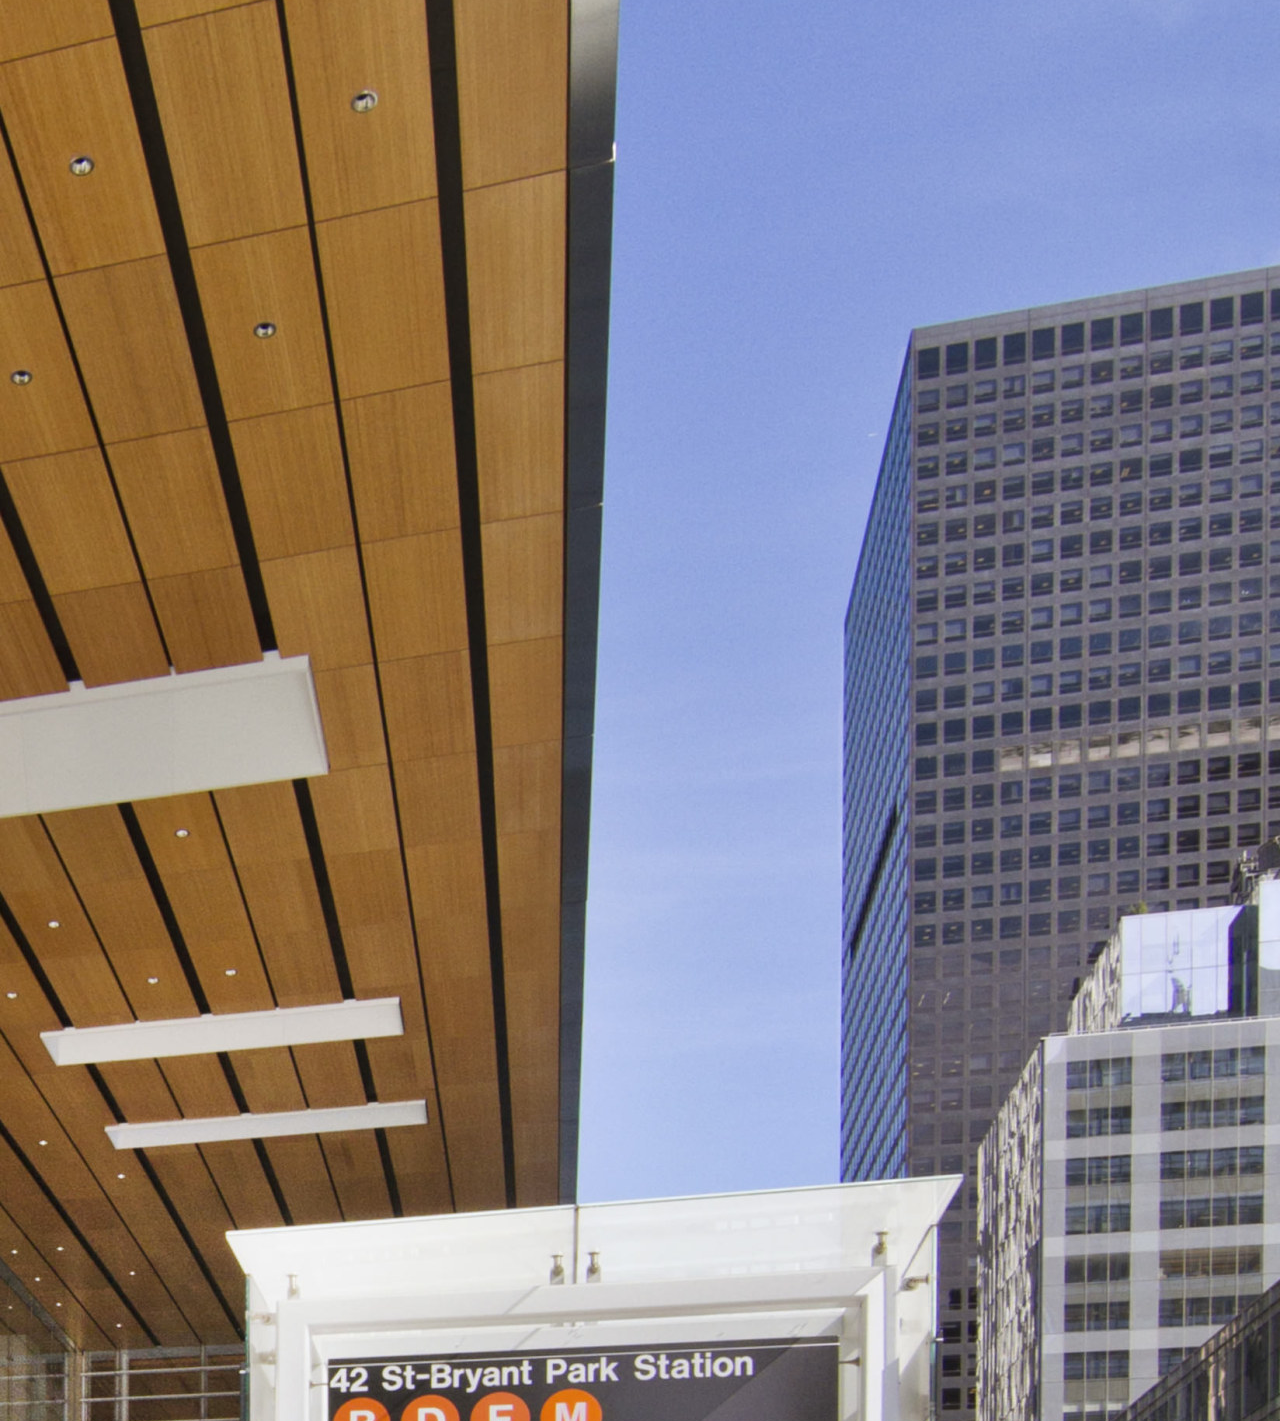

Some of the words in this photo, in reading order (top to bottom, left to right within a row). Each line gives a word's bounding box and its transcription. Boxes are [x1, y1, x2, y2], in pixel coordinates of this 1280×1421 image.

[329, 1367, 369, 1393] 42
[381, 1359, 532, 1393] St-Bryant
[546, 1357, 619, 1384] Park
[634, 1352, 754, 1381] Station
